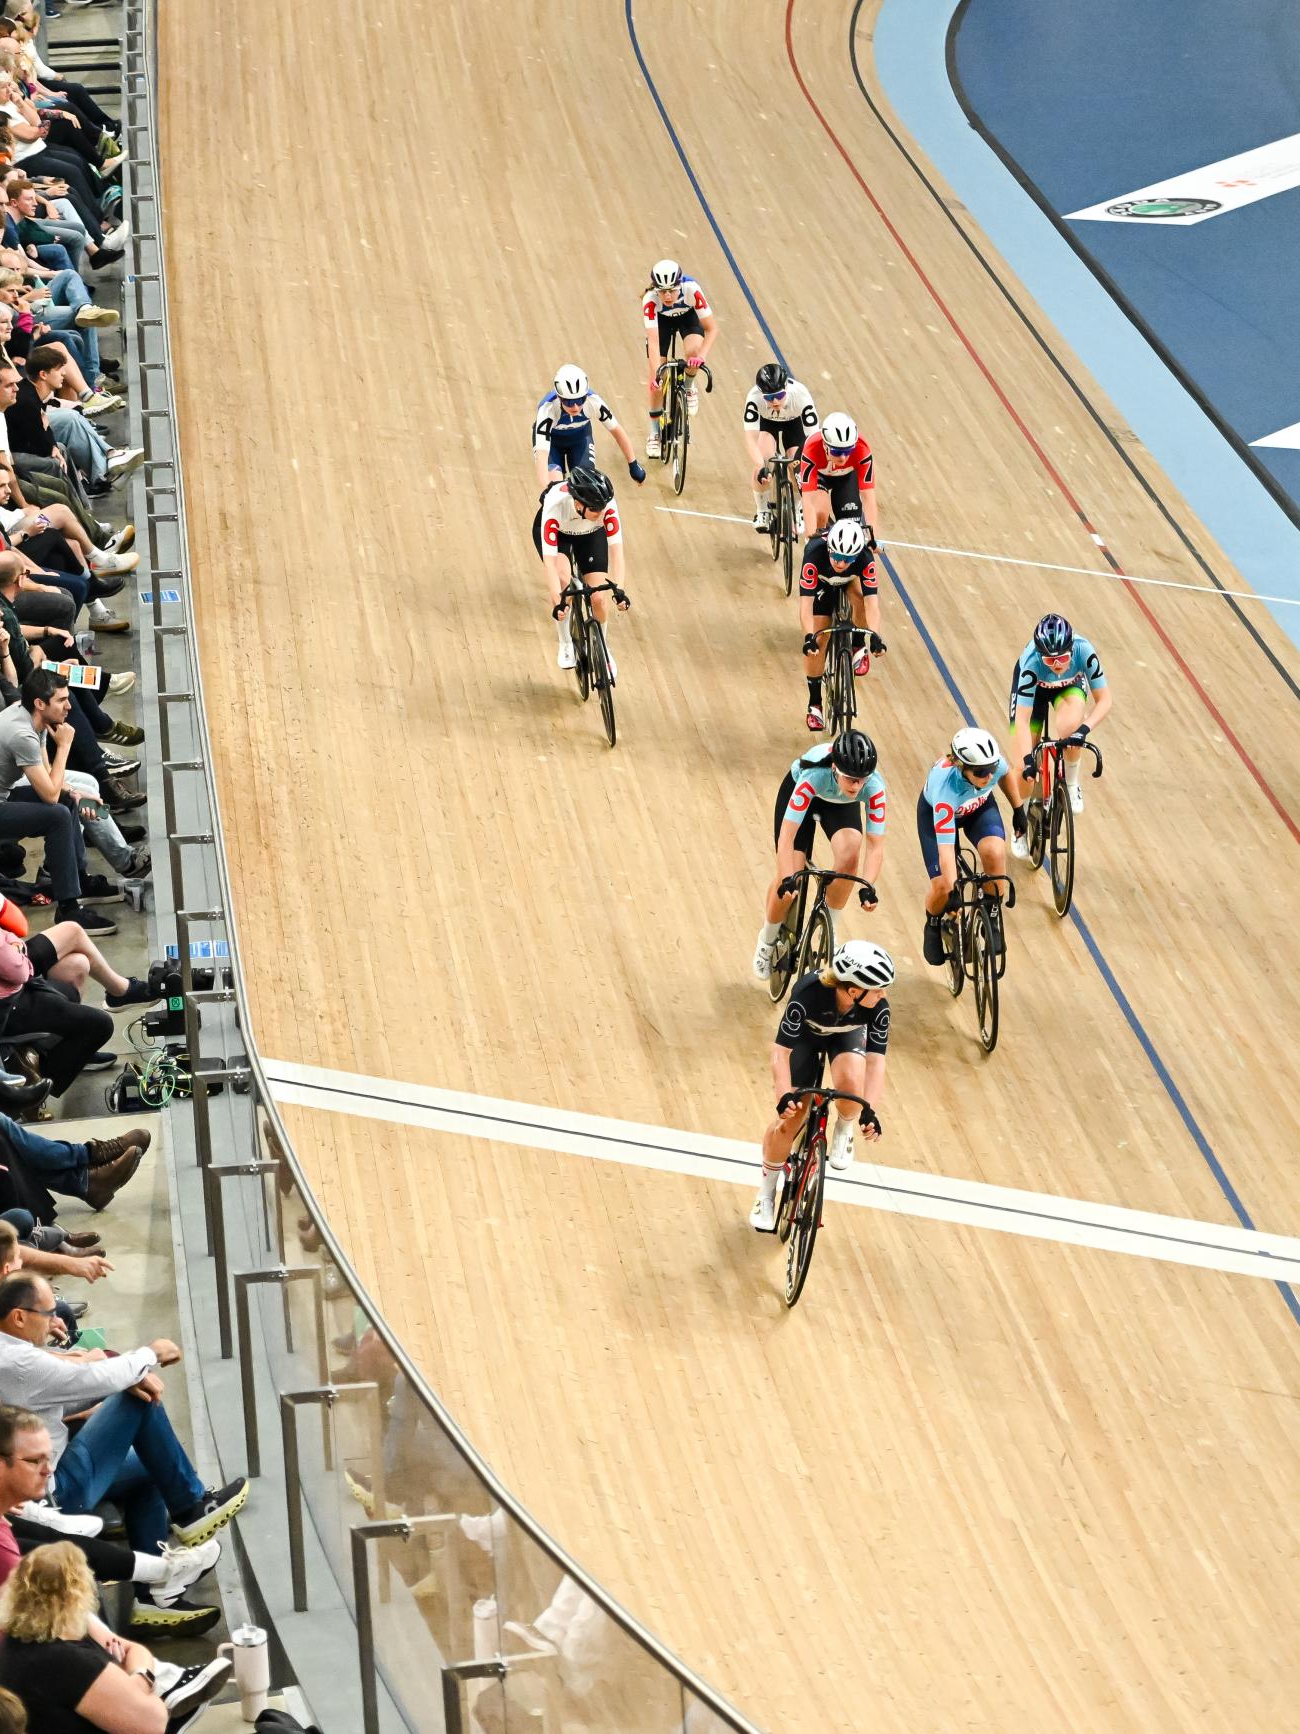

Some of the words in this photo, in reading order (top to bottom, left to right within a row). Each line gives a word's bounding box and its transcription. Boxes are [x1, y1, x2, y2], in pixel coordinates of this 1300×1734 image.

[644, 300, 656, 320] 4
[694, 290, 707, 310] 4
[598, 405, 613, 422] 4
[744, 401, 759, 423] 6
[801, 405, 818, 427] 6
[537, 417, 553, 441] 4
[801, 453, 816, 484] 7
[859, 453, 874, 484] 7
[544, 518, 560, 547] 6
[603, 508, 620, 538] 6
[800, 562, 819, 590] 9
[862, 561, 878, 588] 9
[1086, 653, 1104, 681] 2
[1017, 669, 1038, 698] 2
[788, 780, 816, 812] 5
[868, 790, 886, 824] 5
[934, 802, 955, 834] 2
[780, 1000, 807, 1038] 9
[869, 1007, 891, 1045] 9
